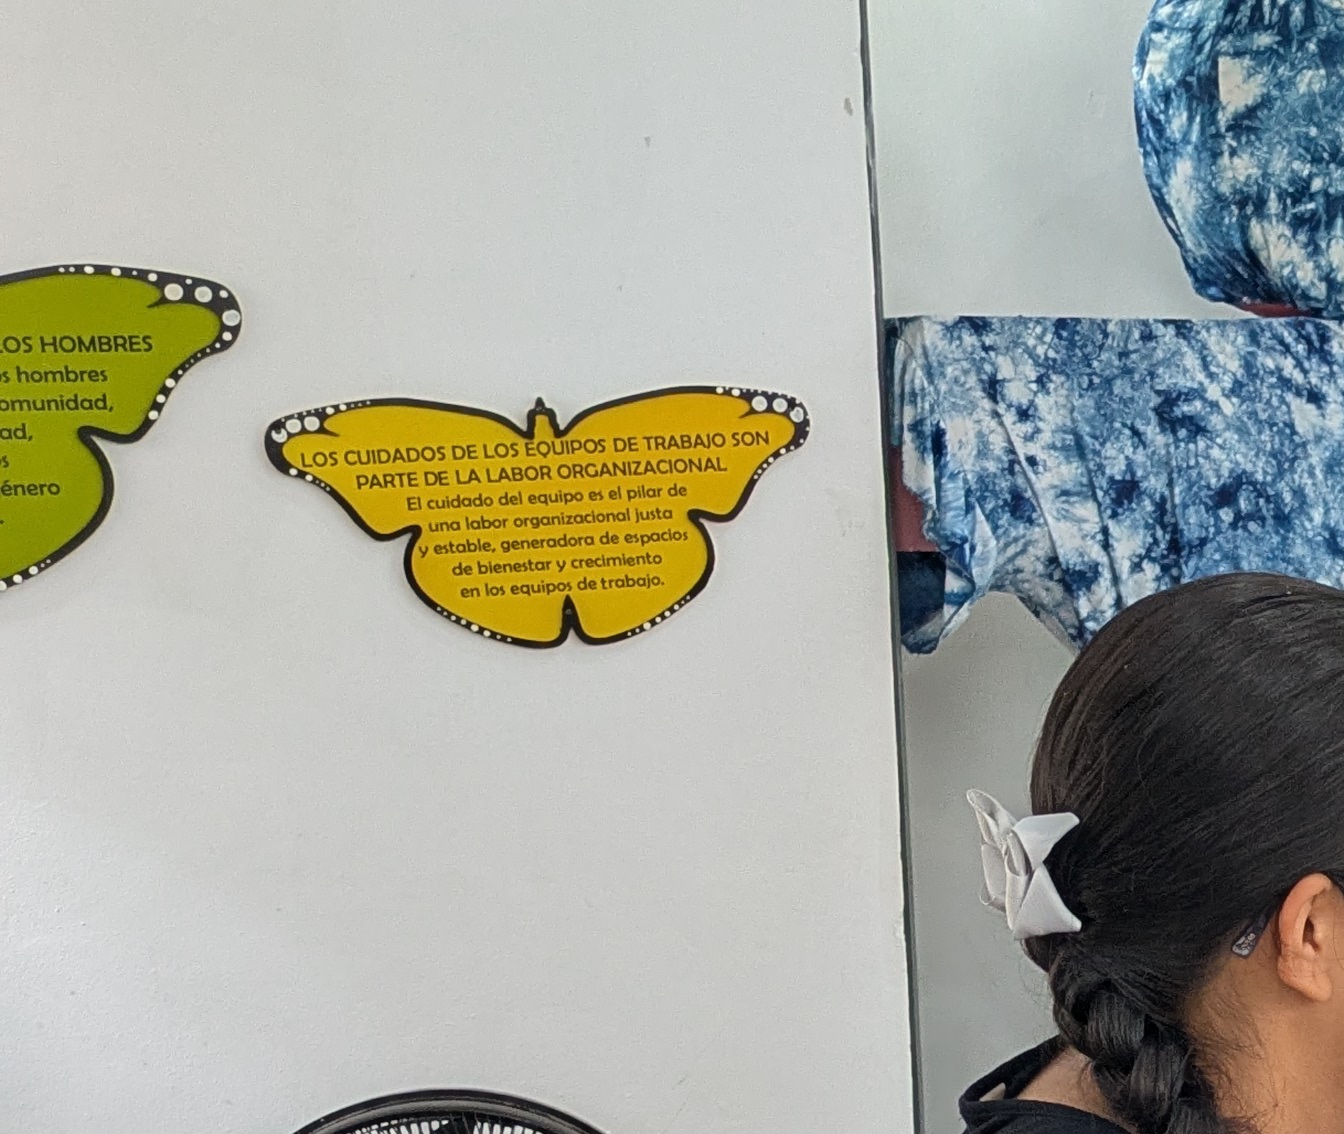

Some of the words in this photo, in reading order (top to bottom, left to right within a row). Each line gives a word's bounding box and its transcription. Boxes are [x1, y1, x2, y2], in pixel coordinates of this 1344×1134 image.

[40, 335, 153, 353] HOMBRES
[16, 365, 108, 383] hombres
[301, 451, 338, 468] LOS
[344, 446, 446, 466] CUIDADOS
[452, 444, 479, 461] DE
[483, 442, 519, 459] LOS
[525, 438, 606, 458] EQUIPOS
[613, 436, 639, 453] DE
[643, 432, 726, 450] TRABAJO
[731, 430, 770, 446] SON
[356, 472, 419, 489] PARTE
[424, 470, 449, 487] DE
[455, 468, 481, 485] LA
[486, 465, 552, 483] LABOR
[557, 457, 728, 480] ORGANIZACIONAL
[406, 497, 421, 511] El
[427, 493, 493, 509] cuidado
[498, 491, 523, 506] del
[528, 489, 584, 506] equipo
[588, 488, 604, 500] es
[608, 486, 622, 499] el
[627, 485, 663, 503] pilar
[667, 484, 687, 497] de
[428, 520, 461, 533] una
[466, 516, 508, 530] labor
[513, 508, 630, 531] organizacional
[635, 507, 673, 524] justa
[418, 545, 429, 558] y
[433, 538, 496, 555] estable,
[500, 531, 595, 551] generadora
[599, 530, 619, 545] de
[624, 529, 688, 547] espacios
[452, 561, 473, 576] de
[477, 558, 551, 574] bienestar
[556, 559, 566, 573] y
[571, 552, 662, 570] crecimiento
[460, 586, 480, 598] en
[485, 582, 505, 596] los
[510, 581, 572, 598] equipos
[577, 577, 597, 591] de
[601, 574, 665, 591] trabajo.
